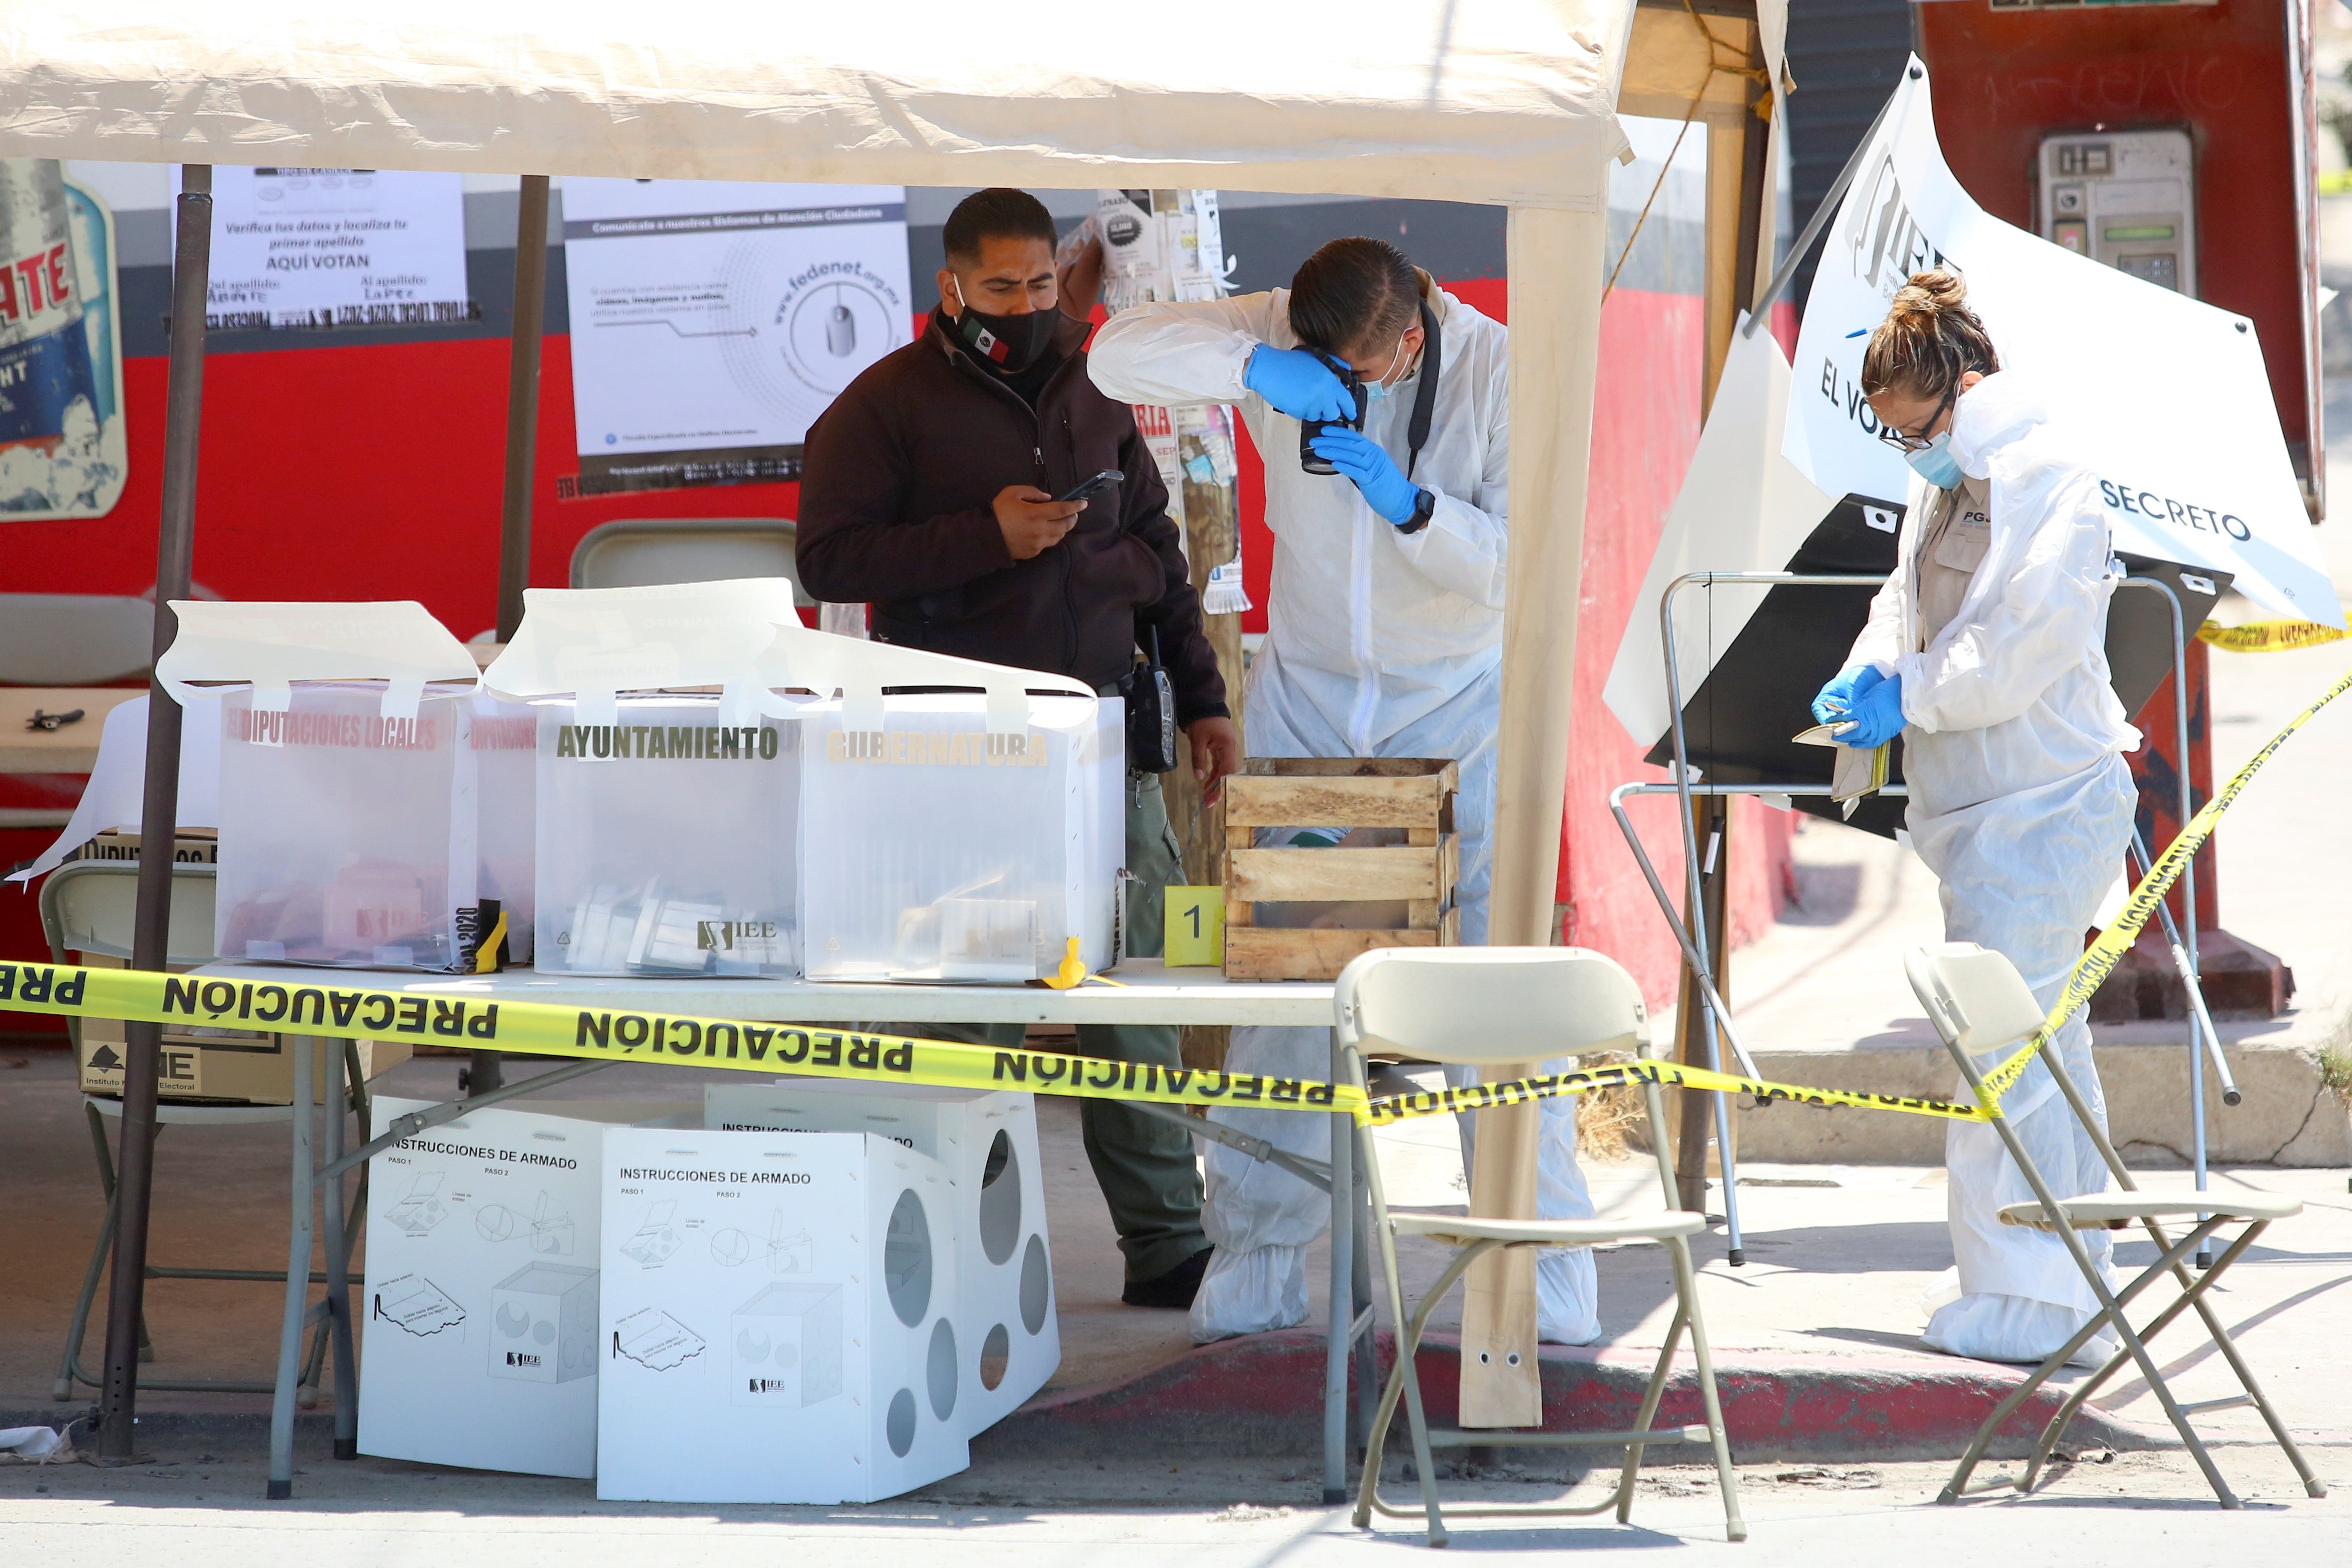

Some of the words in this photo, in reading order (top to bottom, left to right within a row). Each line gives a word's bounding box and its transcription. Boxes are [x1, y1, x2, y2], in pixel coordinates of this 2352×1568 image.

[225, 223, 271, 234] Verifica
[276, 223, 293, 232] tus
[297, 221, 330, 231] datos
[343, 219, 390, 230] localiza
[269, 237, 311, 251] primer
[314, 235, 365, 249] apellido
[266, 252, 308, 272] AQUÍ
[311, 255, 370, 269] VOTAN
[1821, 356, 1839, 408] EL
[2100, 479, 2251, 542] SECRETO
[240, 709, 361, 748] DIPUTACIONES
[365, 716, 437, 751] LOCALES
[557, 725, 778, 760] AYUNTAMIENTO
[827, 729, 1049, 767] GUBERNATURA
[735, 922, 777, 938] IEE
[1183, 904, 1200, 939] 1
[162, 977, 498, 1039] PRECAUCIÓN
[575, 1010, 914, 1074] PRECAUCIÓN
[86, 1077, 119, 1086] Instituto
[159, 1082, 195, 1091] Electoral
[992, 1052, 1335, 1106] PRECAUCIÓN
[387, 1139, 495, 1159] NSTRUCCIONES
[499, 1150, 517, 1162] DE
[520, 1153, 578, 1170] ARMADO
[388, 1157, 406, 1165] PASO
[484, 1167, 503, 1175] PASO
[620, 1168, 726, 1183] INSTRUCCIONES
[730, 1172, 748, 1184] DE
[751, 1172, 812, 1186] ARMADO
[524, 1355, 542, 1364] IEE
[767, 1380, 785, 1389] IEE
